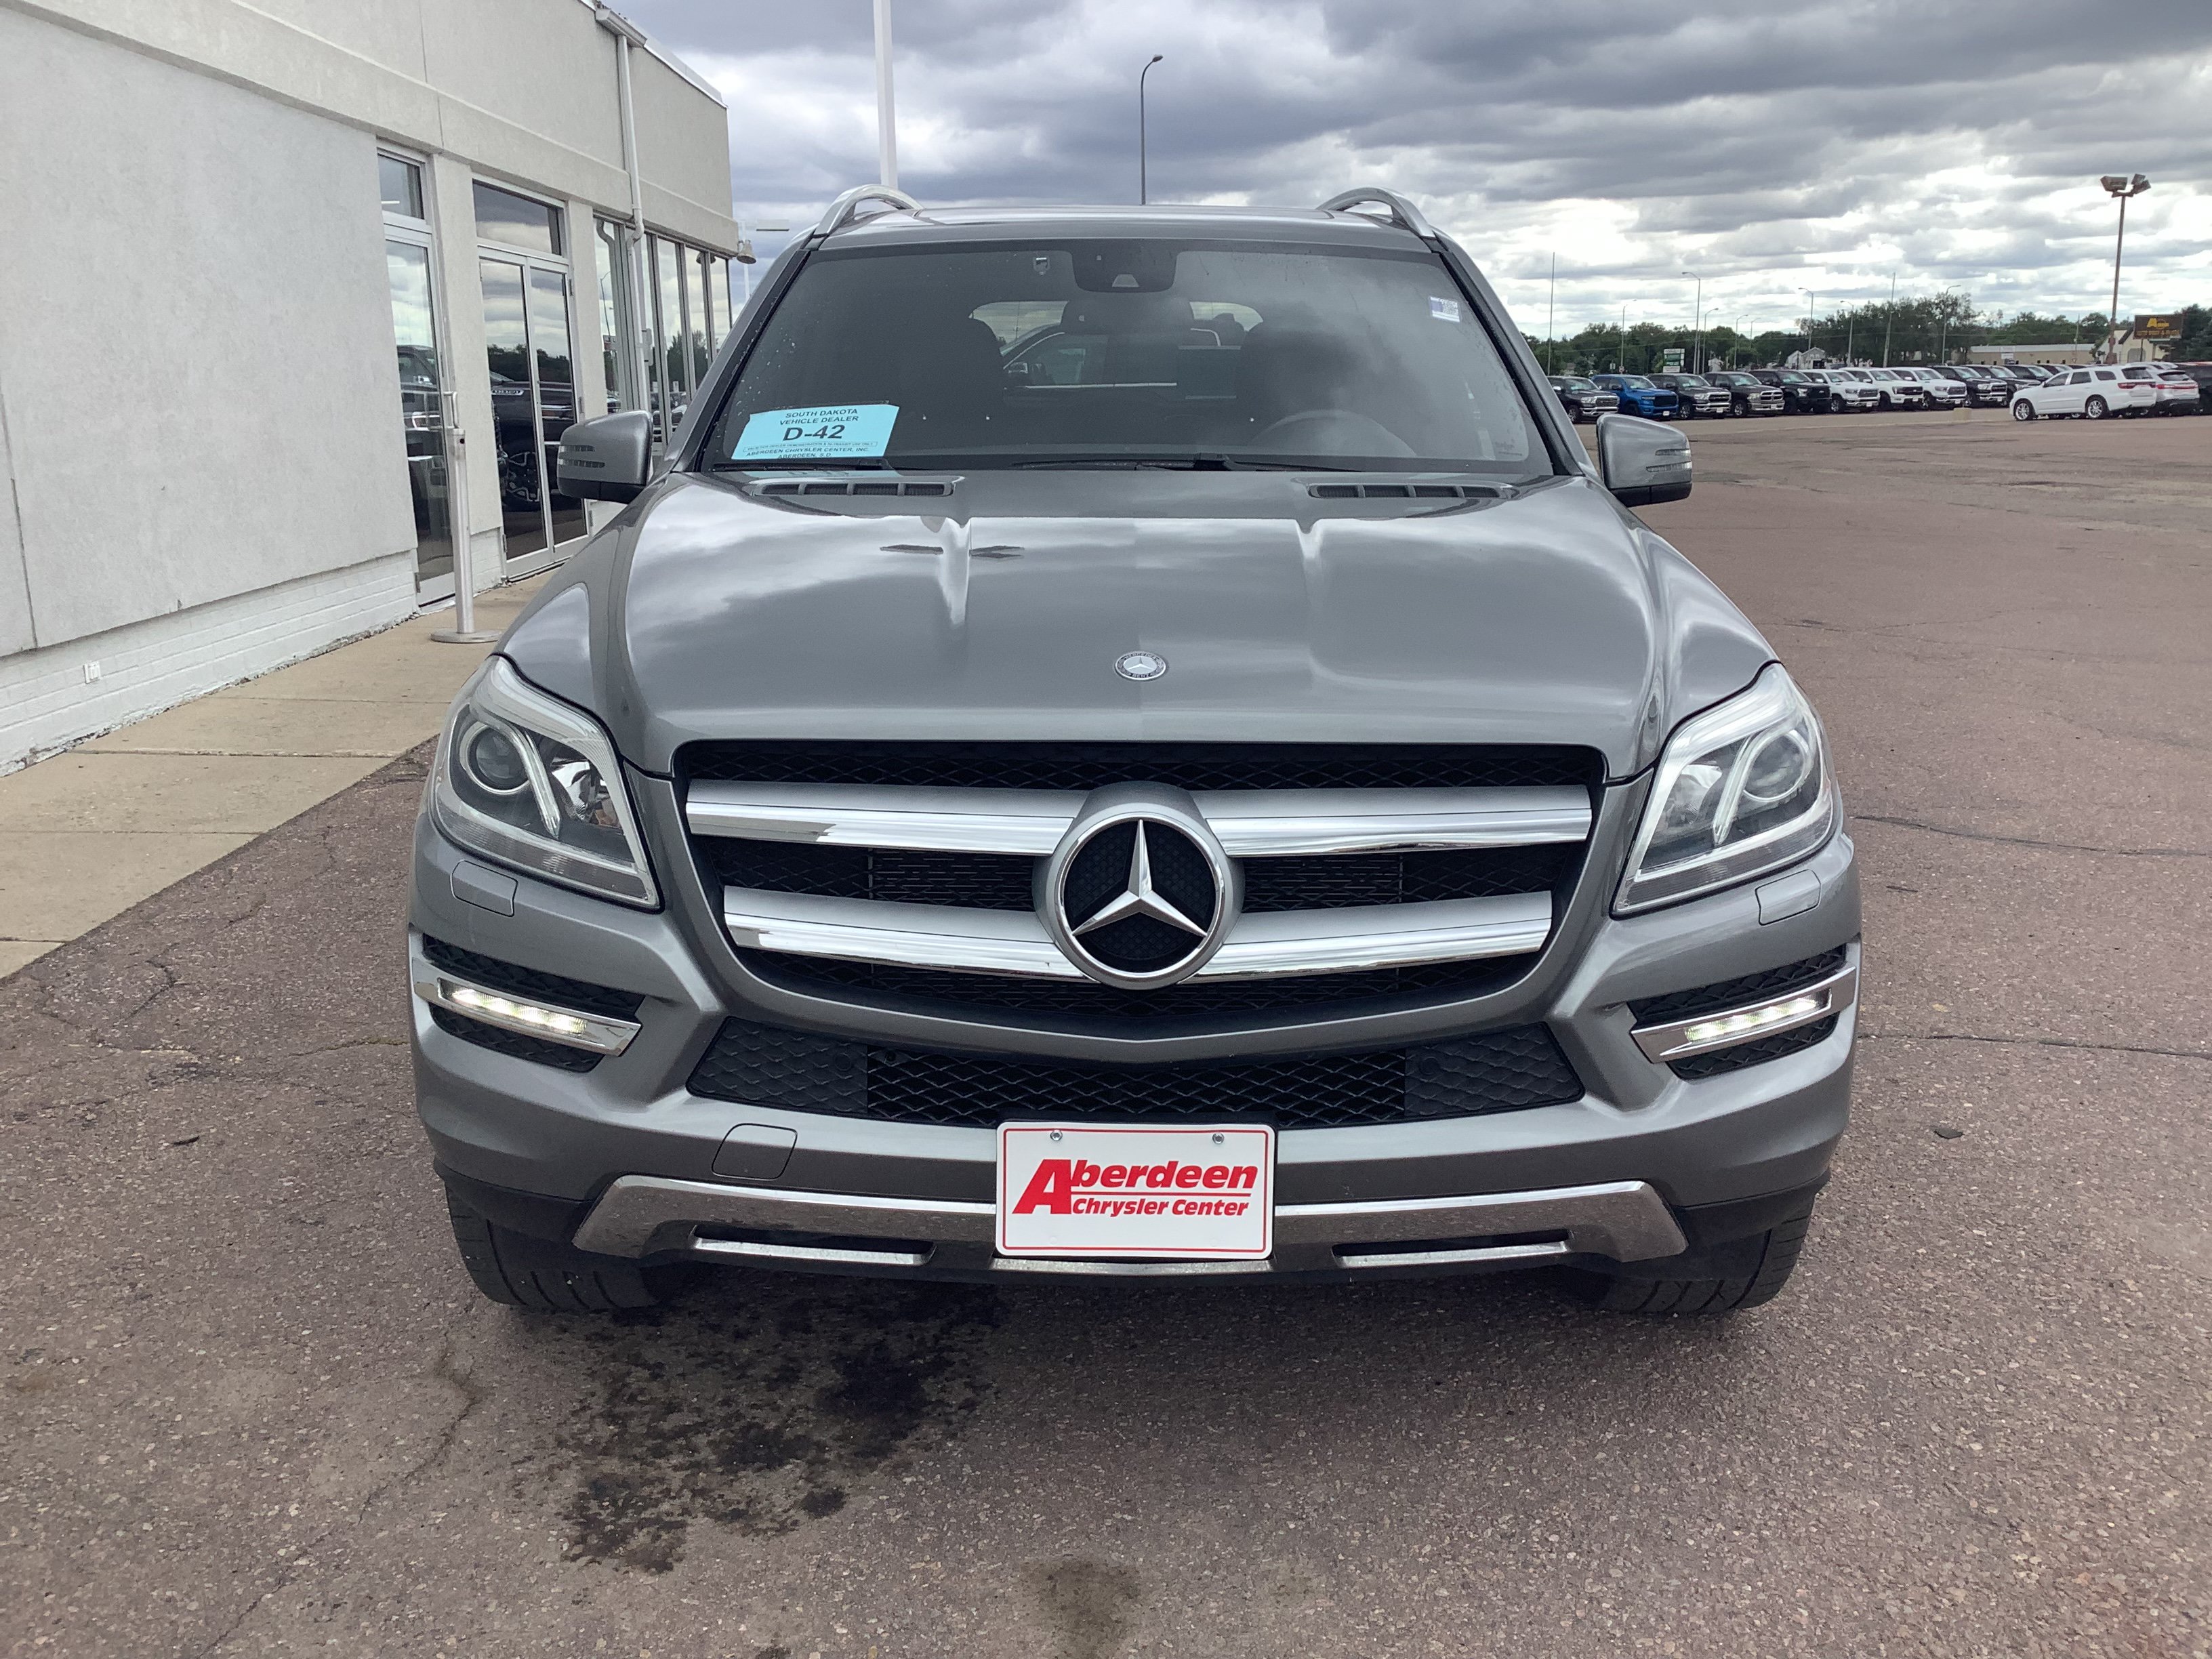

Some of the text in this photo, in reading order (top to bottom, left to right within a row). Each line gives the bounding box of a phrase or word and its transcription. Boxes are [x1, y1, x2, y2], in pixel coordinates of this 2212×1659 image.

[780, 417, 819, 426] VEHICLE
[783, 424, 845, 441] D-42
[1012, 1159, 1258, 1214] Aberdeen
[1073, 1197, 1249, 1217] Chrysler Center
